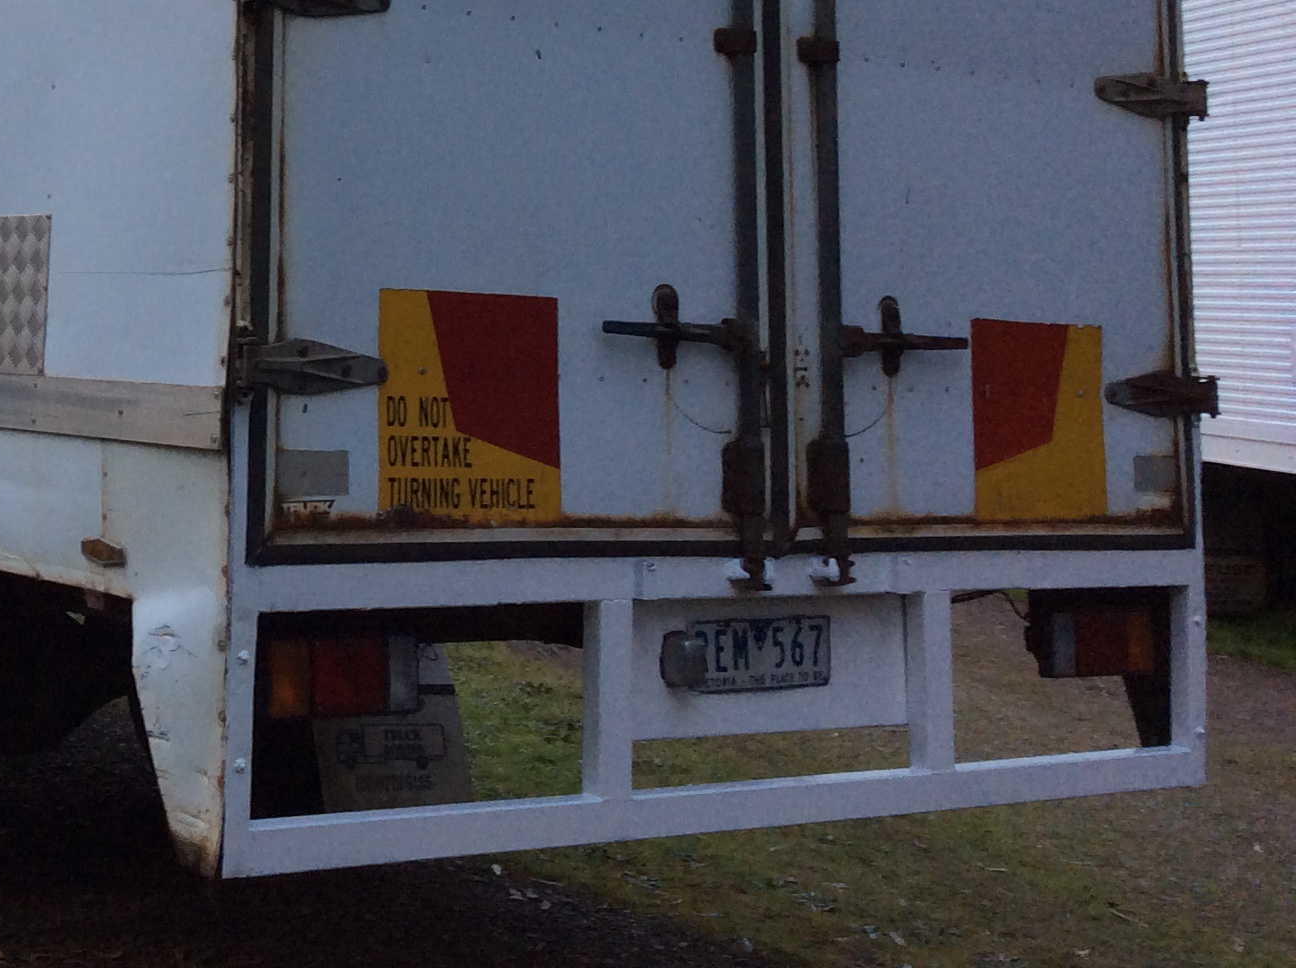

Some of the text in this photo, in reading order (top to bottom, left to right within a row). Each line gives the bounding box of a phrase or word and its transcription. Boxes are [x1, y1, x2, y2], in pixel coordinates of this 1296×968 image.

[386, 395, 450, 428] DO NOT
[387, 434, 473, 468] OVERTAKE
[388, 476, 536, 510] TURNING VEHICLE
[771, 624, 824, 669] 567
